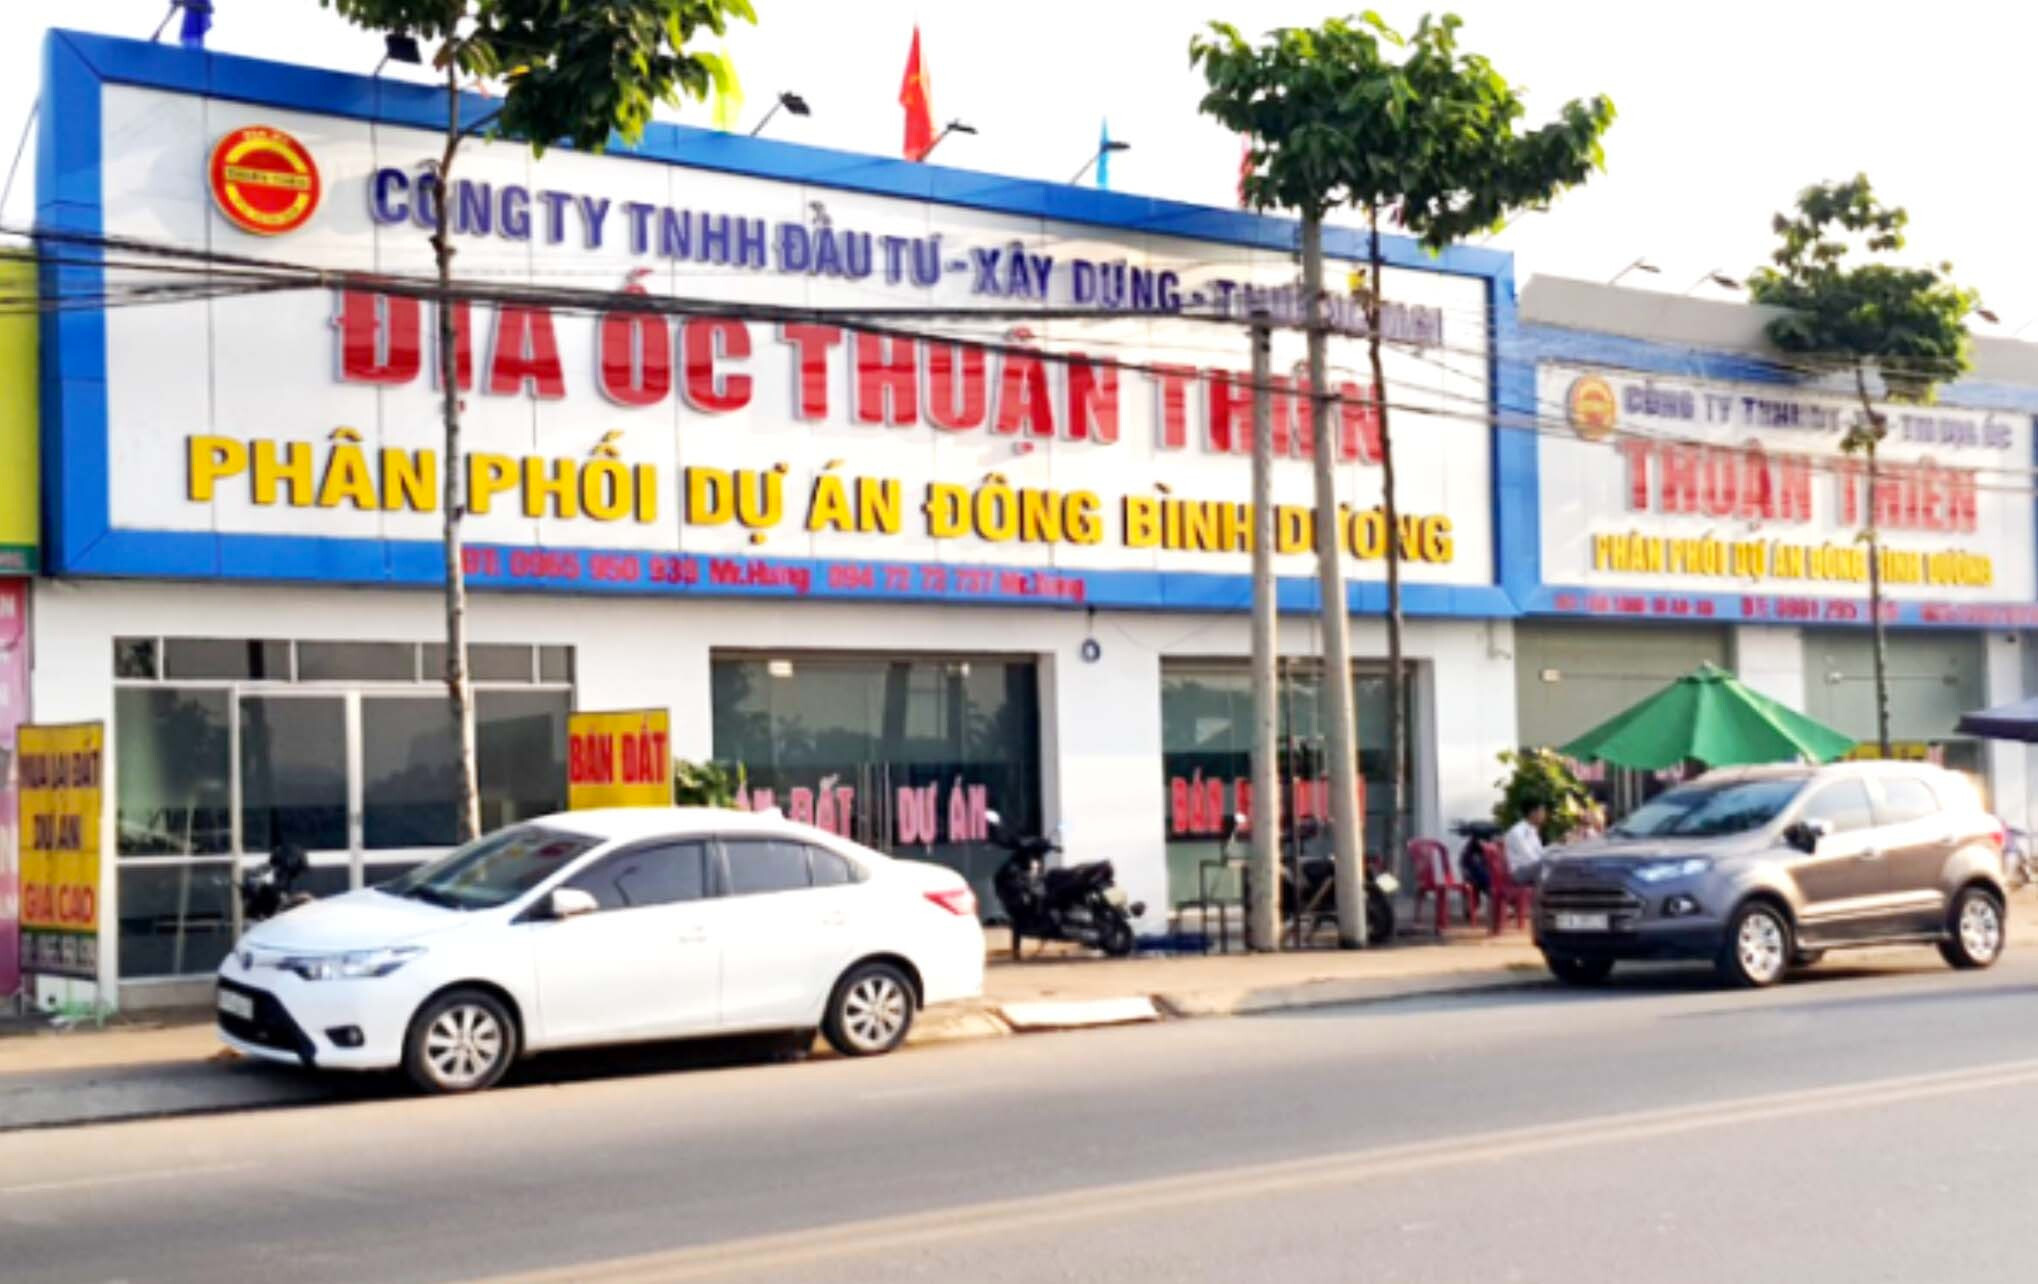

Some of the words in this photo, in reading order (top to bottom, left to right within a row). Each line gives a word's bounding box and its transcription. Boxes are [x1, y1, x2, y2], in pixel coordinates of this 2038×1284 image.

[369, 159, 532, 242] CÔNG
[537, 190, 612, 251] TY
[622, 201, 768, 270] TNHH
[774, 201, 874, 282] ĐẦU
[881, 233, 943, 288] TƯ
[970, 240, 1054, 304] XÂY
[333, 272, 567, 413] ĐỊA
[597, 267, 753, 414] ỐC
[778, 318, 1122, 456] THUẬN
[186, 426, 437, 513] PHÂN
[466, 429, 658, 524] PHỐI
[685, 462, 789, 546] DỰ
[807, 459, 903, 535] ÁN
[921, 472, 1102, 546] ĐÔNG
[1122, 482, 1255, 553] BÌNH
[1614, 437, 1812, 530] THUẬN
[1827, 453, 1976, 533] THIÊN
[1880, 545, 1921, 583] ÌNH
